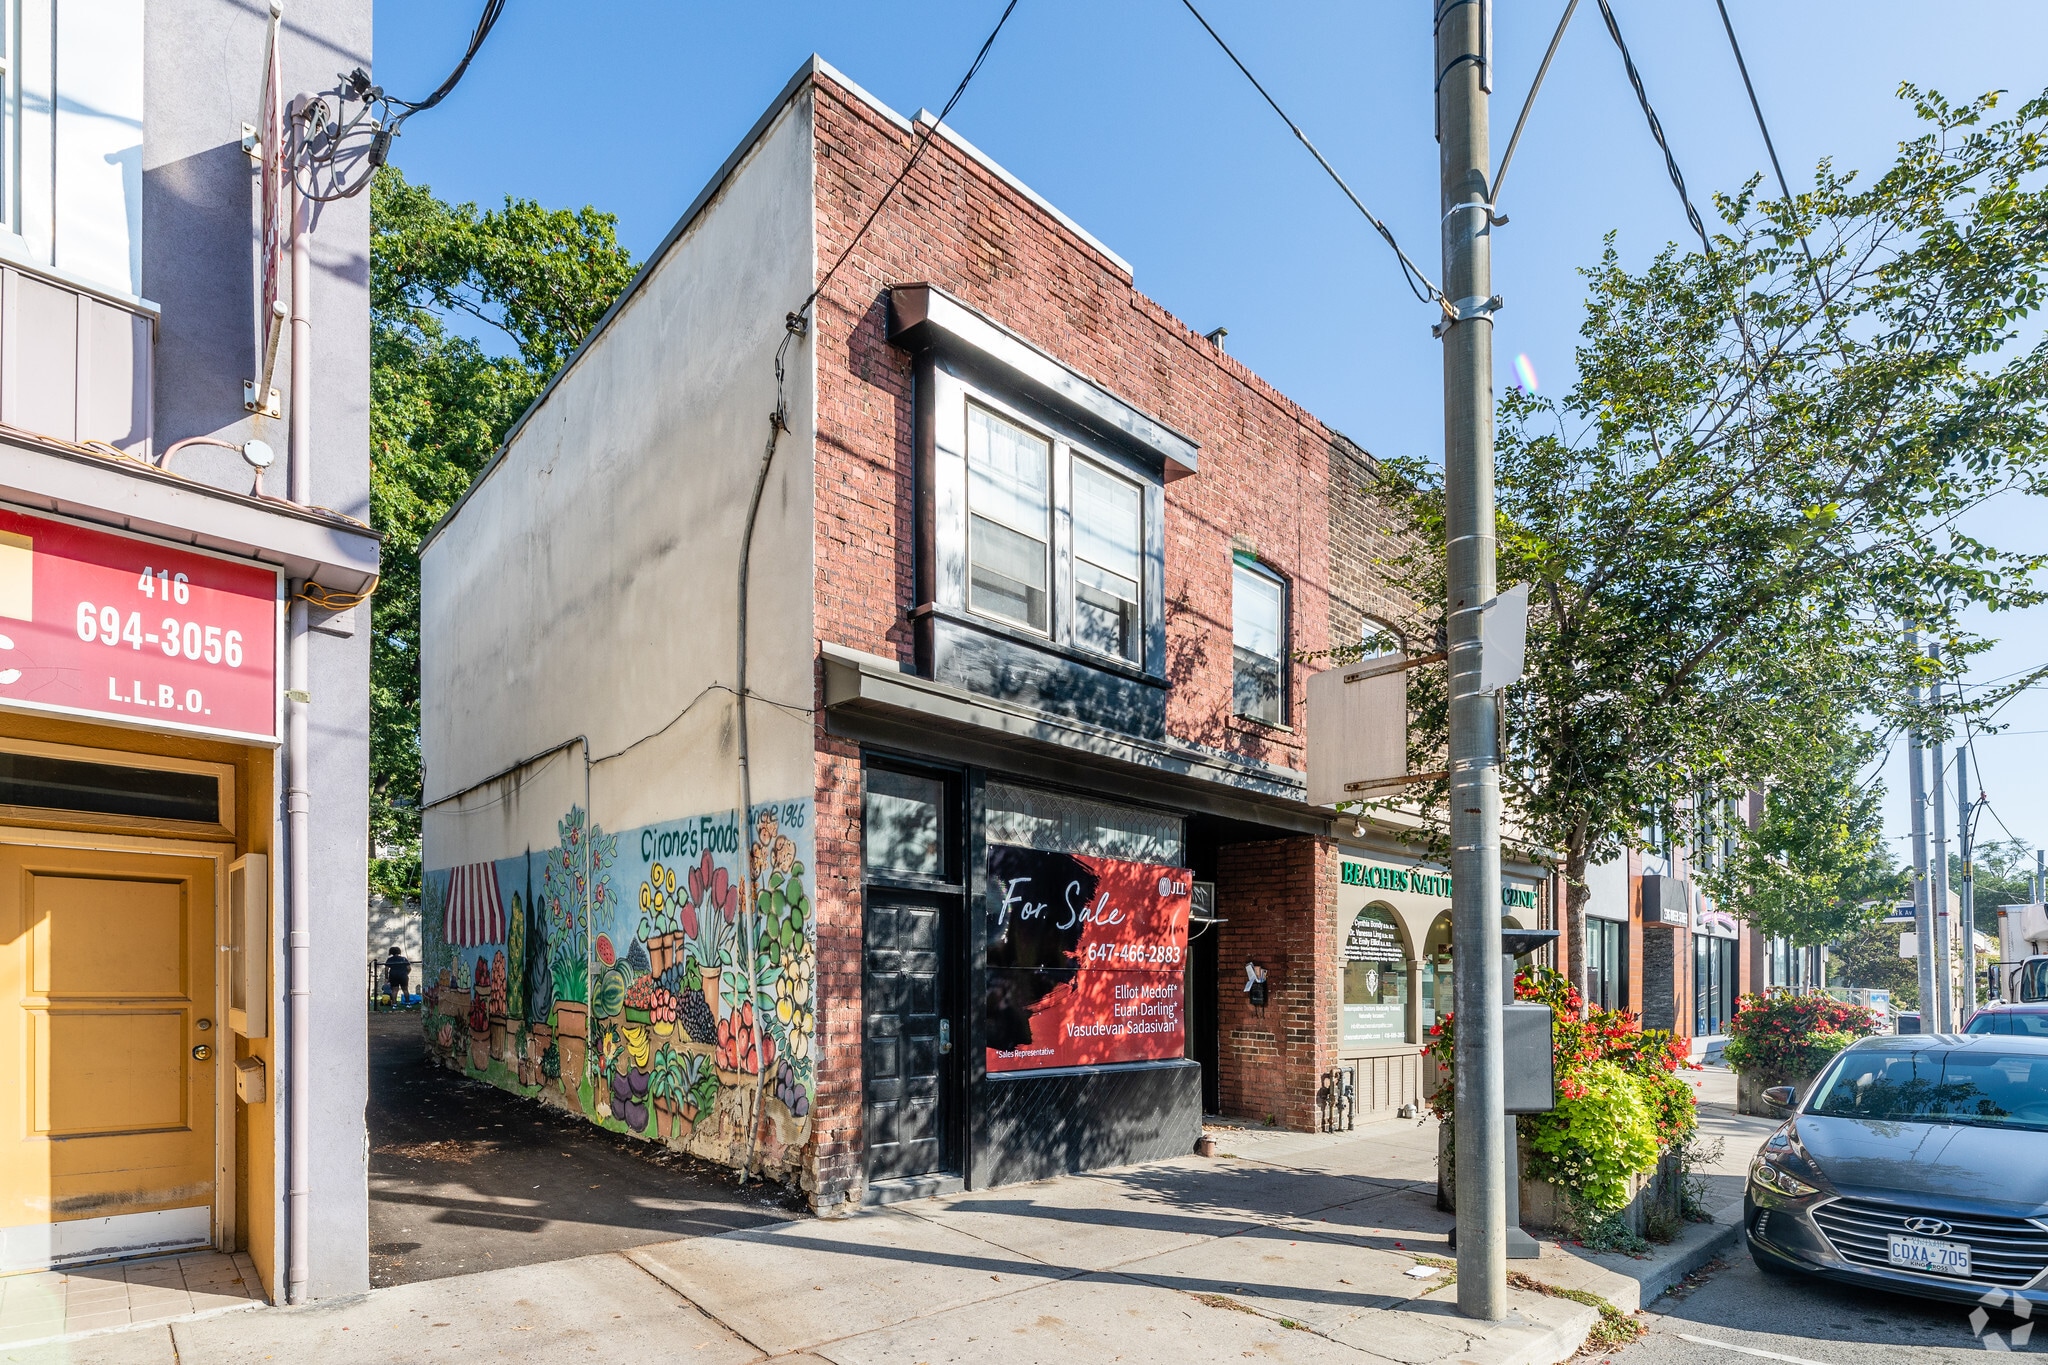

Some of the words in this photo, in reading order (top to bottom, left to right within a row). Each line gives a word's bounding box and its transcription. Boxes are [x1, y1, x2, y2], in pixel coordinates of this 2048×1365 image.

[138, 566, 190, 605] 416
[76, 601, 243, 668] 694-3056
[108, 677, 211, 715] L.L.B.O.
[780, 803, 805, 828] 1966
[641, 819, 698, 862] Cirone's
[700, 808, 739, 854] Foods
[1341, 861, 1409, 892] BEACHES
[1502, 887, 1538, 909] CLINIC
[998, 877, 1047, 926] For
[1056, 880, 1126, 930] Sale
[1088, 943, 1181, 963] 647-466-2883
[1115, 985, 1139, 999] Elliot
[1114, 1003, 1138, 1017] Euan
[1066, 1021, 1125, 1037] Vasudevan
[1014, 1048, 1055, 1058] Representative
[1892, 1242, 1929, 1262] CDXA
[1939, 1249, 1968, 1268] 705
